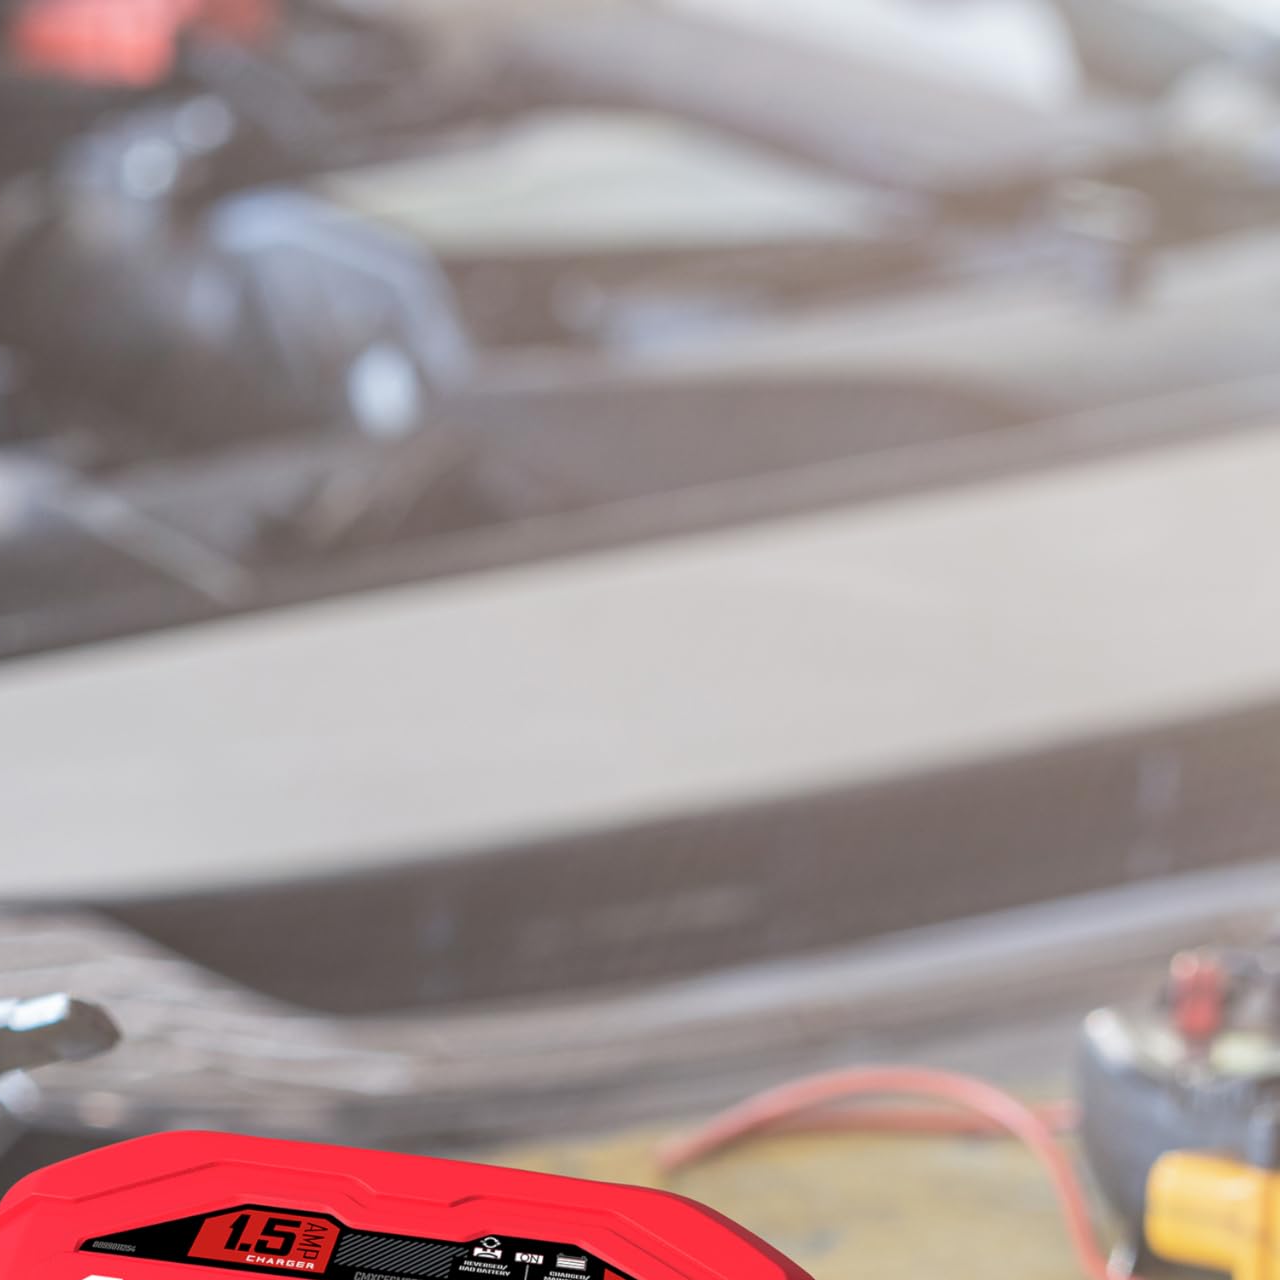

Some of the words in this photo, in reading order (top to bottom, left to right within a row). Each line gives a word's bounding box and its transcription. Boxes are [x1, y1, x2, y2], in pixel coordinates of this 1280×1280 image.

[224, 1214, 300, 1256] 1.5
[296, 1222, 328, 1261] AMP
[246, 1254, 314, 1270] CHARGER
